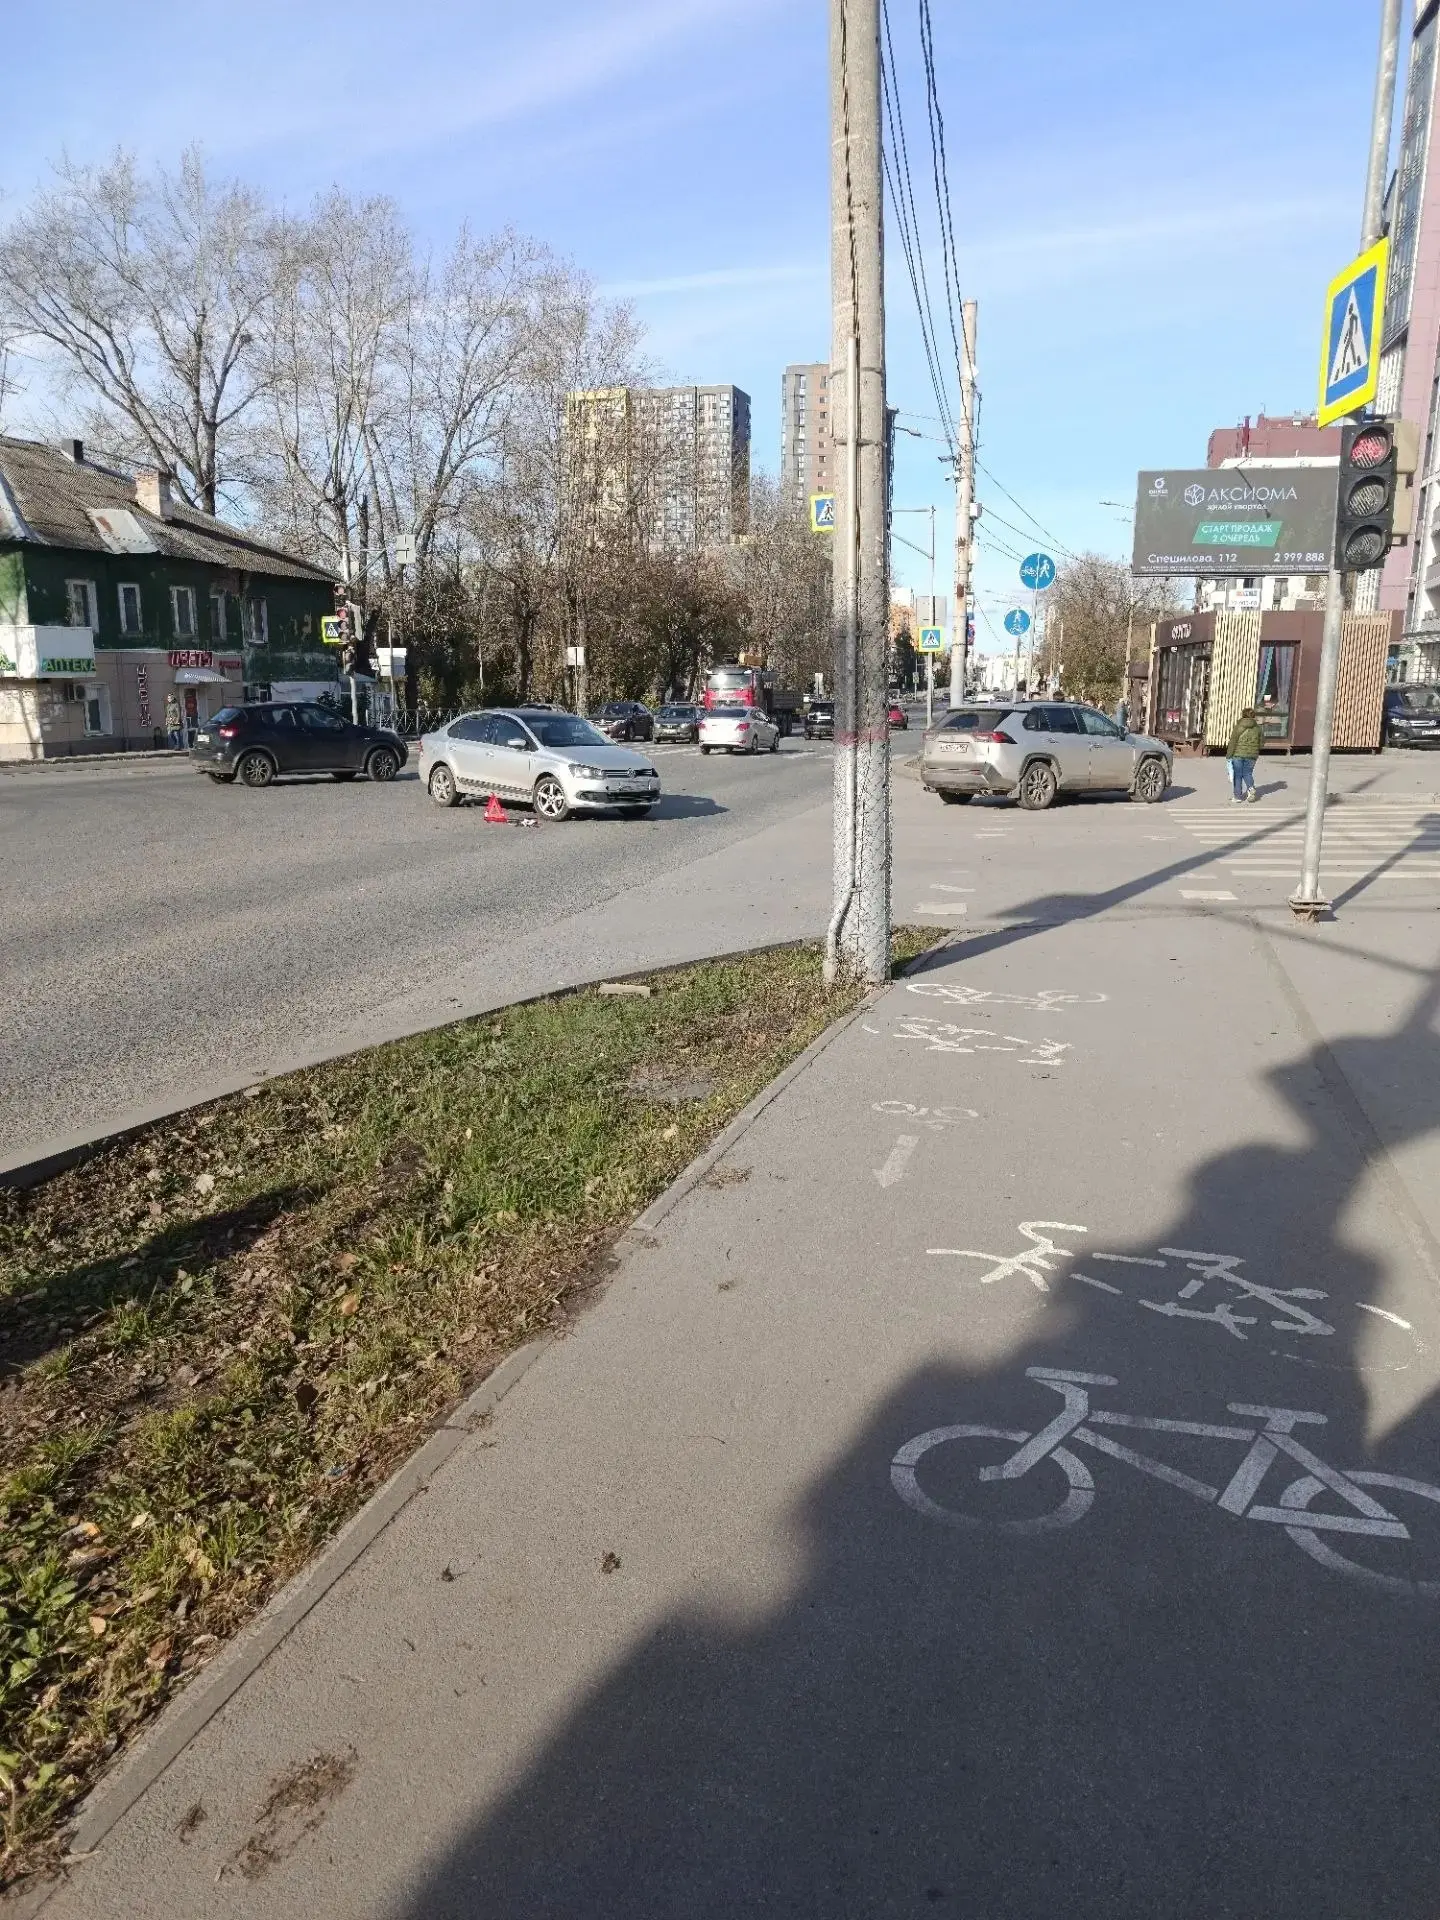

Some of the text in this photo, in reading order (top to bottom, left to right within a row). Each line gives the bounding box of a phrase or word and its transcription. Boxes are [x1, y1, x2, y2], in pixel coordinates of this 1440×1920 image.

[1207, 486, 1298, 501] АКСИОМА
[1201, 523, 1273, 534] СТАРТ ПРОДАЖ
[1212, 534, 1261, 543] 2 ОЧЕРЕДЬ
[1218, 553, 1238, 563] 112
[1273, 552, 1325, 562] 2 999 888
[45, 657, 97, 672] АПТЕКА
[171, 651, 215, 668] ЦВЕТЫ
